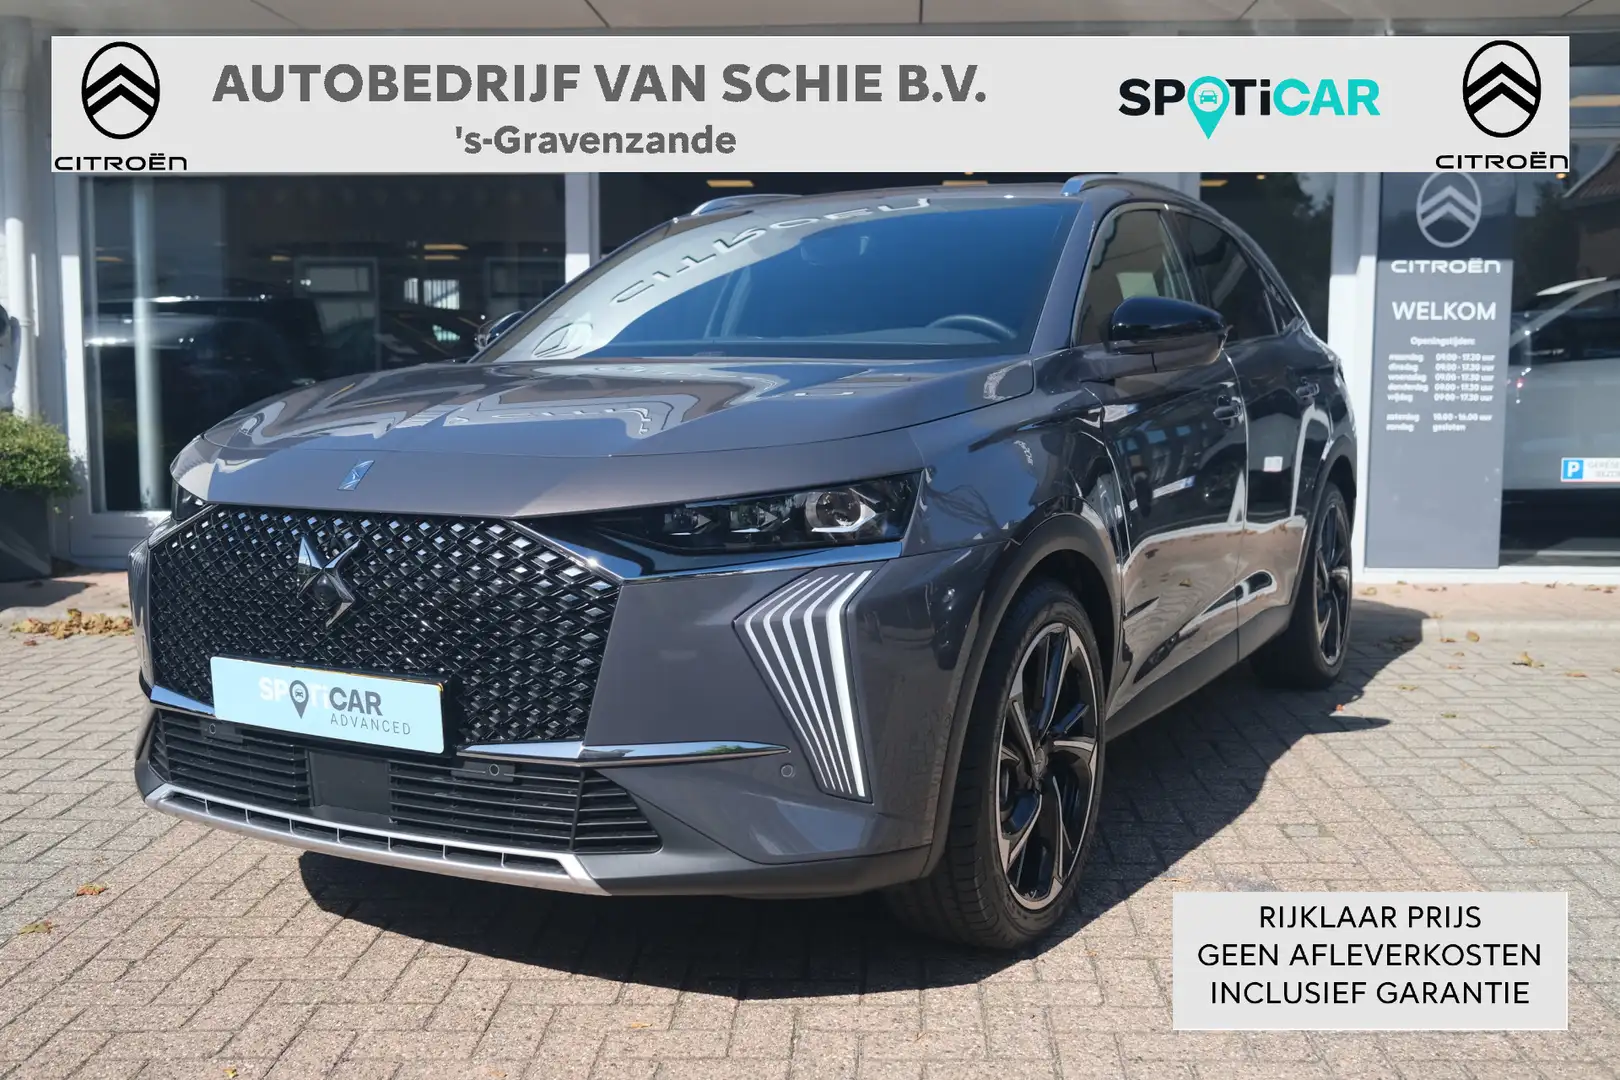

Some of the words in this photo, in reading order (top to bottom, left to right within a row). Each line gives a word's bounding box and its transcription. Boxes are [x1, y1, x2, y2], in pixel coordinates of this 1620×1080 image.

[1392, 301, 1497, 321] WELKOM
[1567, 461, 1580, 478] P
[330, 713, 411, 735] ADVANCED
